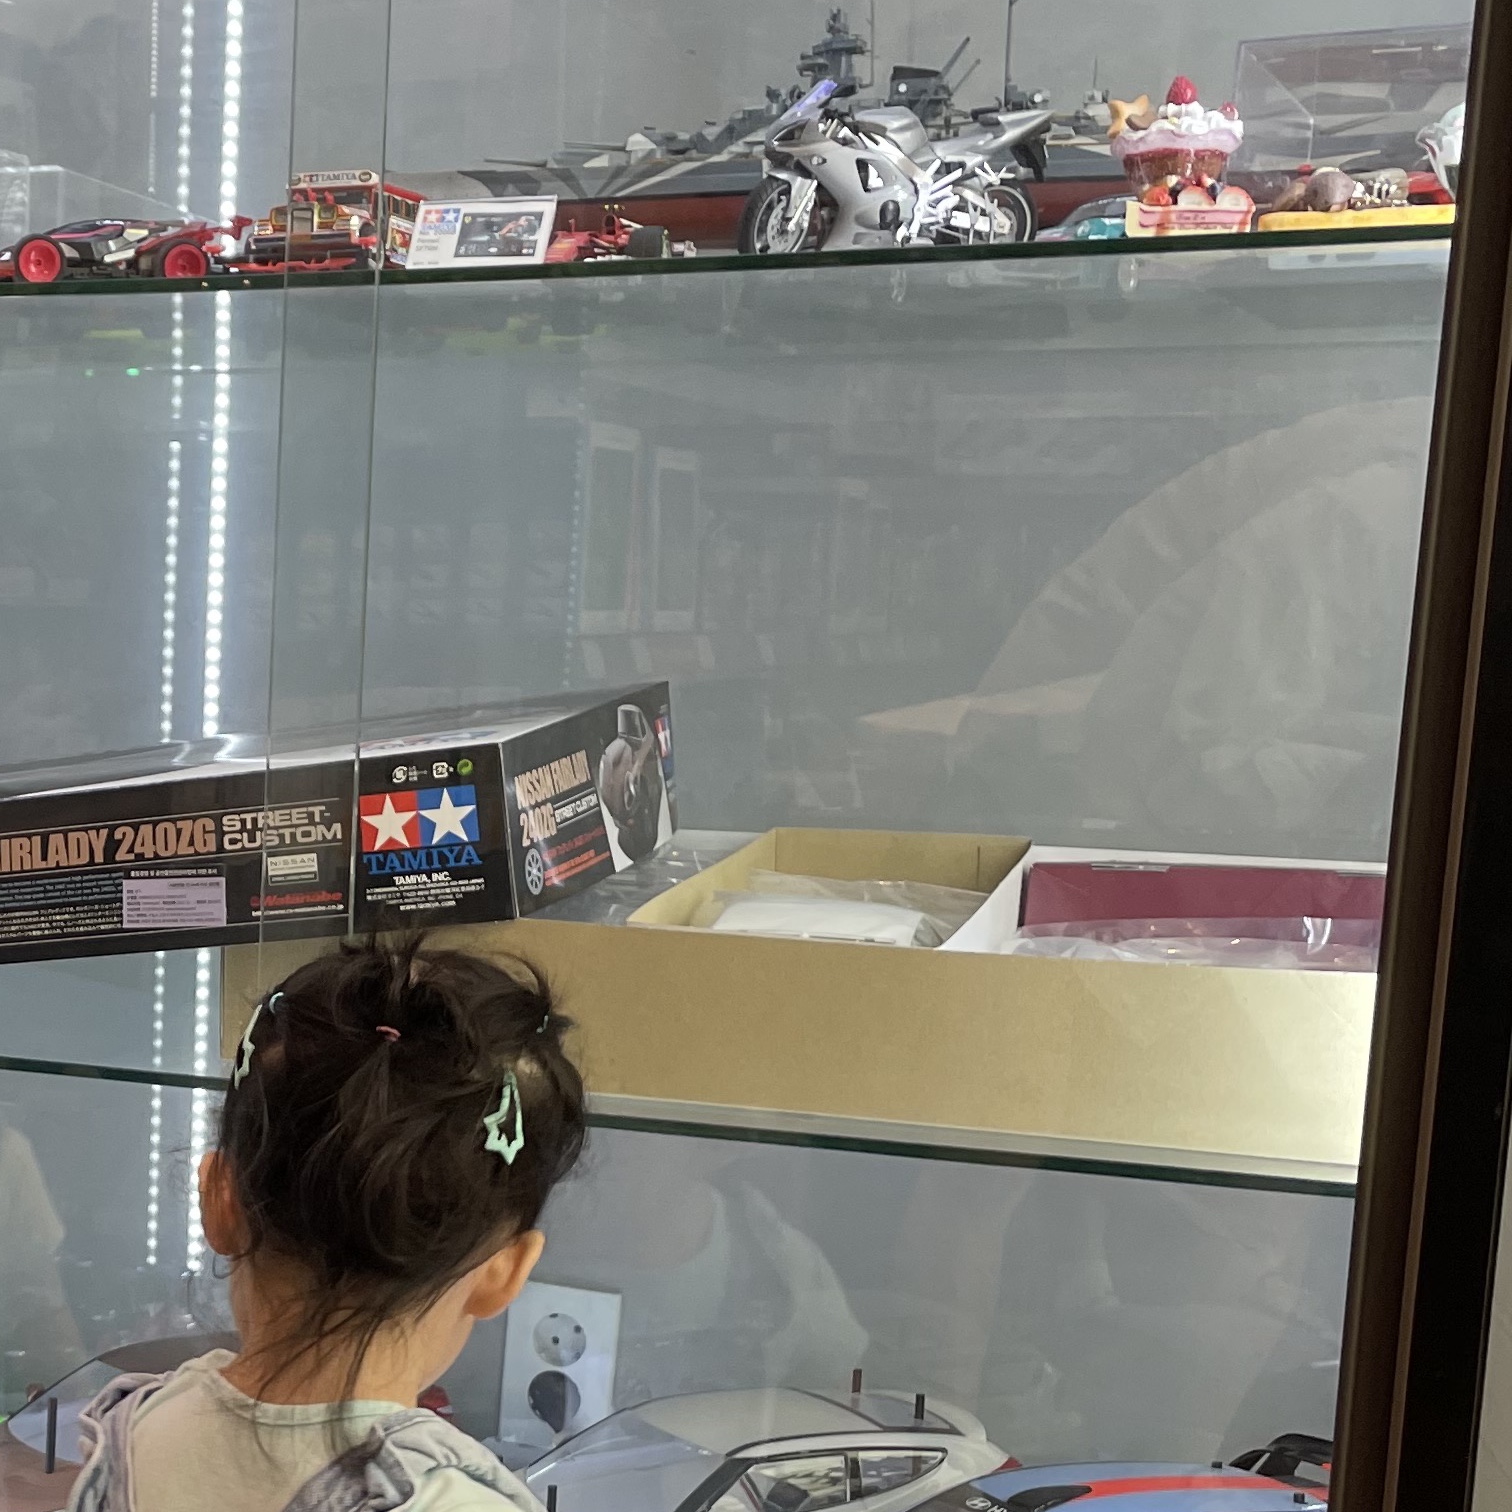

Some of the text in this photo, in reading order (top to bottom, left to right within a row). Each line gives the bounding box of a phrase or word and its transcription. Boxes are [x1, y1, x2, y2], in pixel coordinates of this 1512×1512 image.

[321, 172, 357, 181] TAMIYA
[222, 806, 331, 831] STREET-
[114, 817, 216, 861] 240ZG
[223, 822, 342, 850] CUSTOM
[269, 857, 316, 867] NISSAN
[362, 844, 483, 875] TAMIYA
[393, 873, 431, 885] TAMIYA,
[431, 871, 452, 882] INC.
